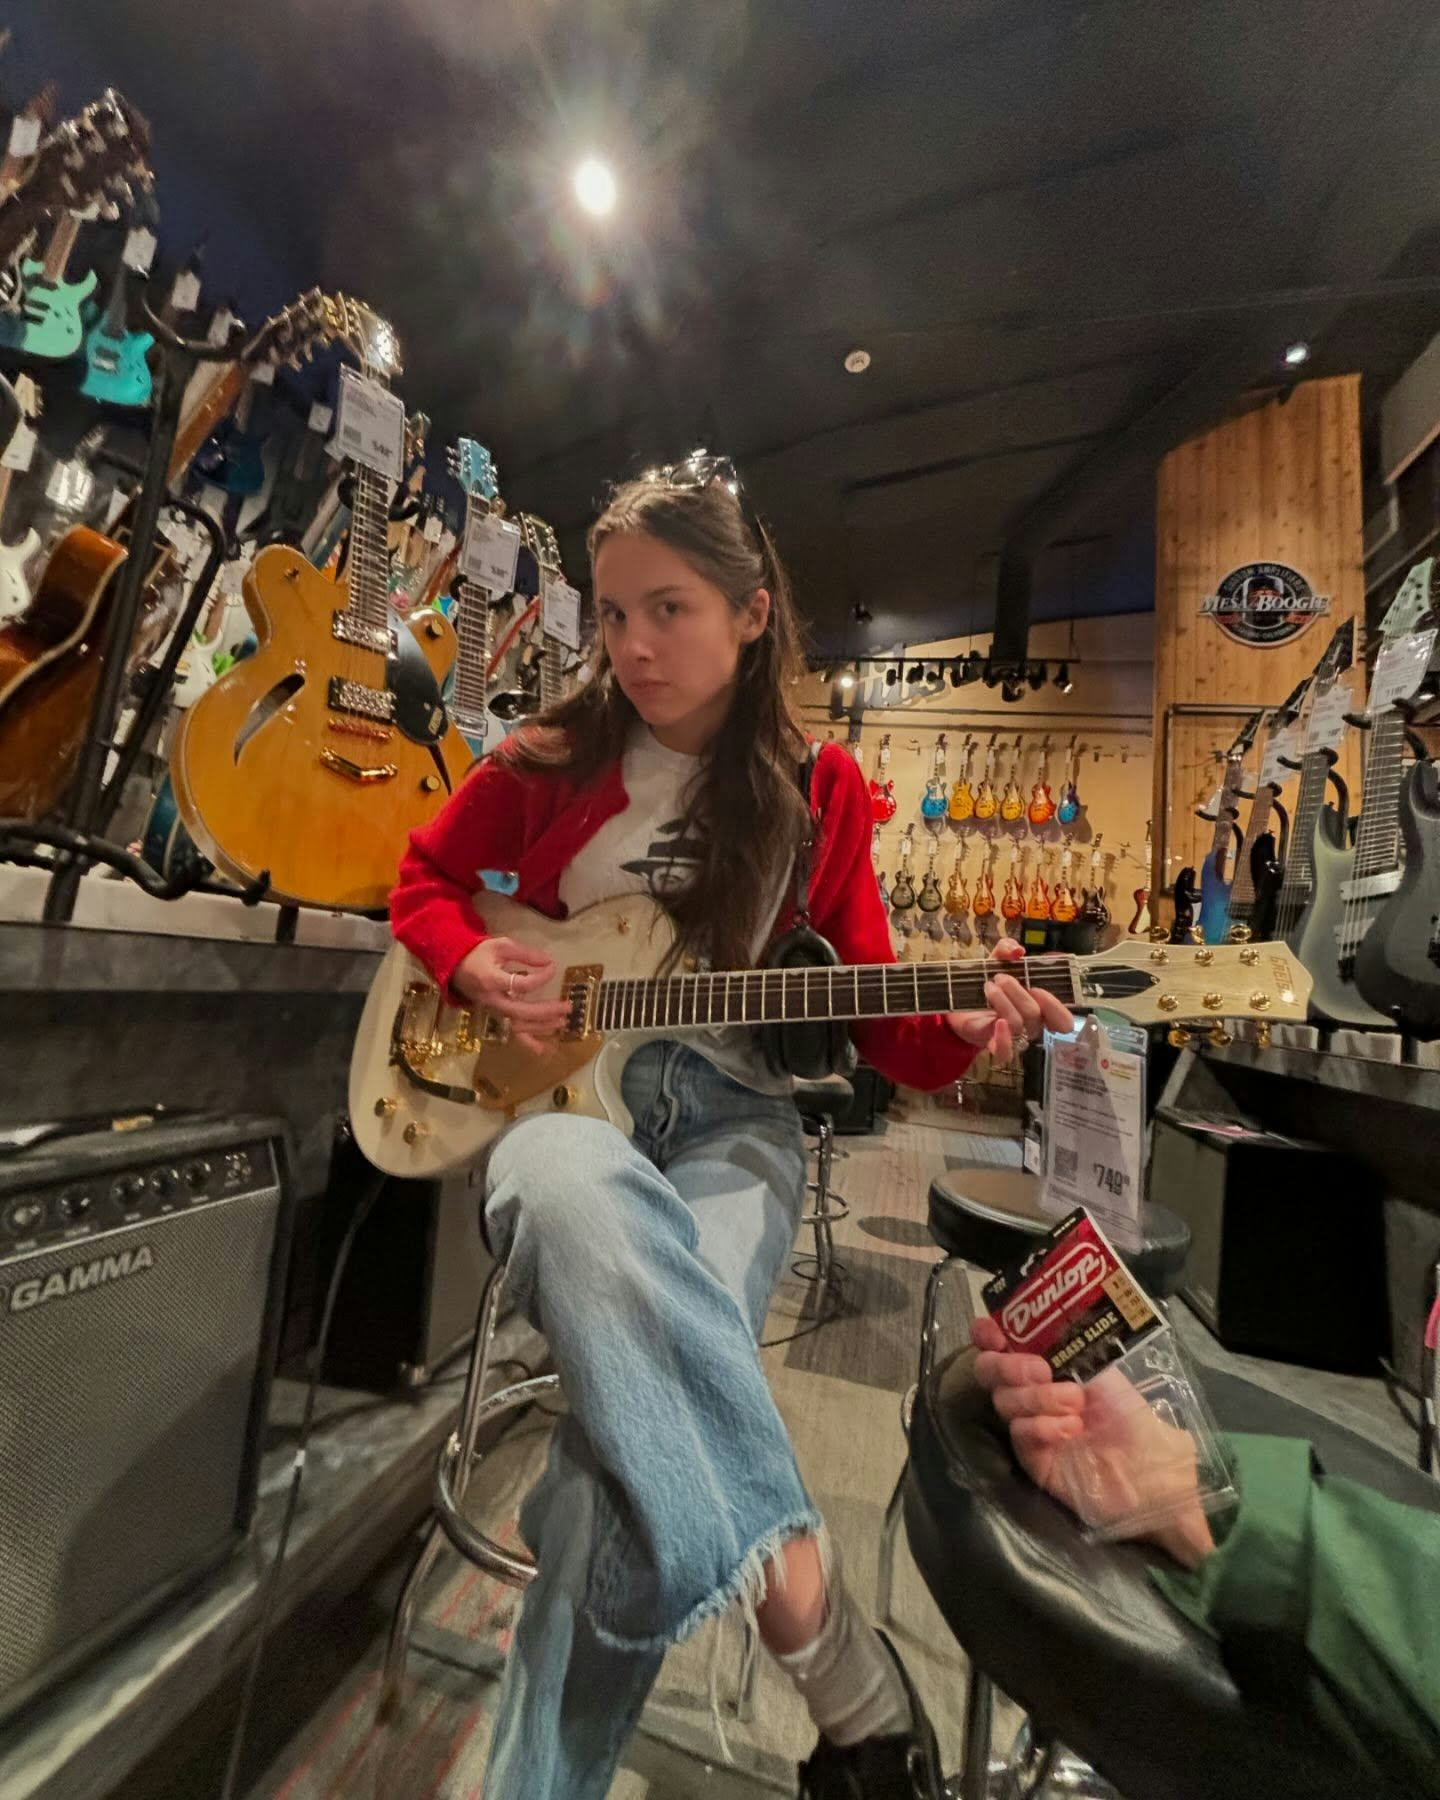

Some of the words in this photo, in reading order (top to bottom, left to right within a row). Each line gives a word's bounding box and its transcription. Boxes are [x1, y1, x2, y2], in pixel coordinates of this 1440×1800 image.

[1256, 594, 1329, 612] BOOGIE
[10, 1247, 152, 1312] GAMMA
[1008, 1253, 1100, 1334] Dunlop
[1051, 1336, 1086, 1368] BRASS
[1084, 1311, 1120, 1342] SLIDE
